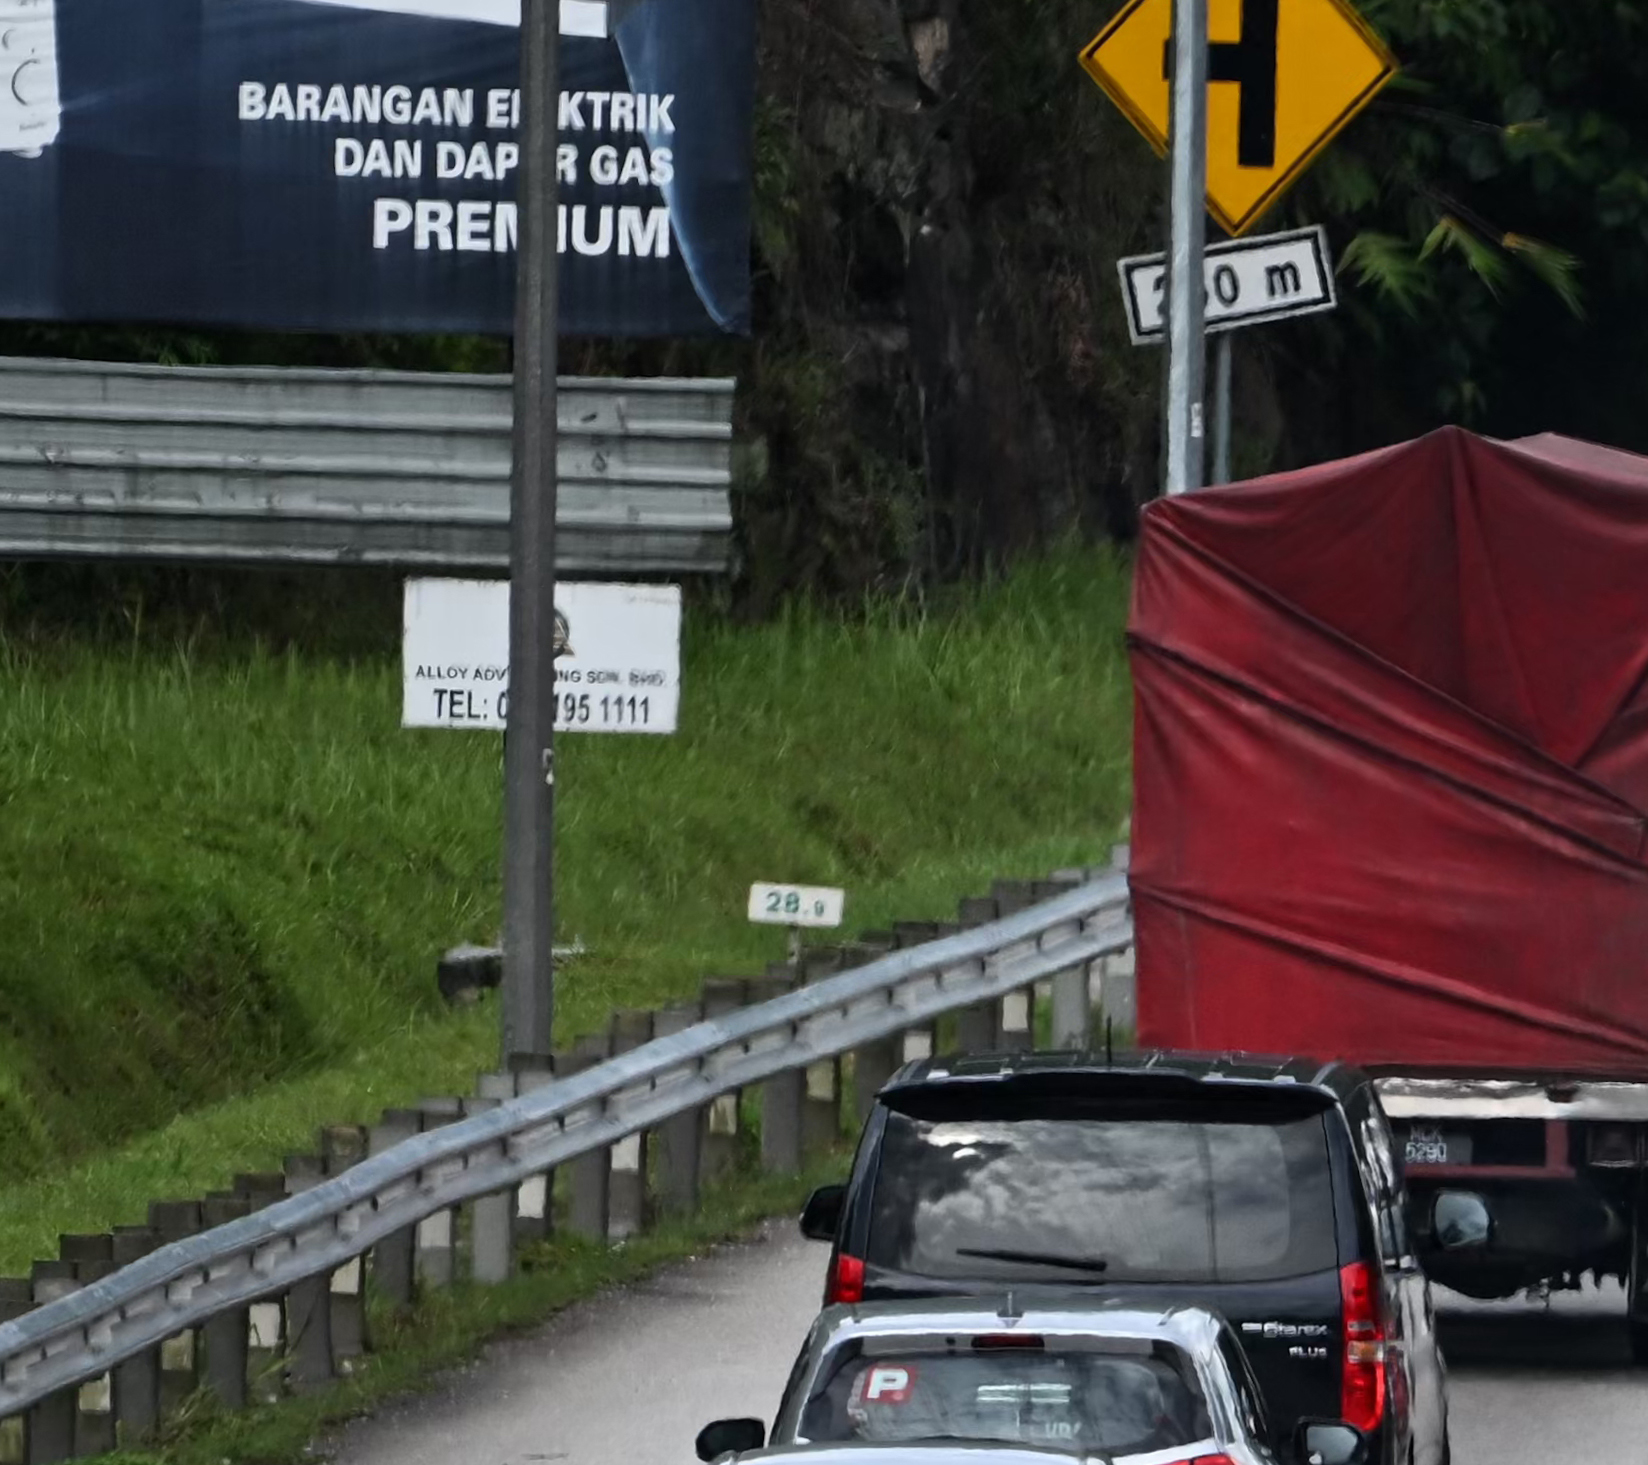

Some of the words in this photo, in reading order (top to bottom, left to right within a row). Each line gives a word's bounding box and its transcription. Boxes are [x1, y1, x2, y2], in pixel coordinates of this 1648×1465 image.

[238, 82, 473, 127] BARANGAN
[334, 138, 422, 178] DAN
[436, 141, 579, 185] DAPR
[590, 145, 675, 187] GAS
[1264, 261, 1301, 297] m
[414, 665, 468, 680] ALLOY
[433, 689, 488, 720] TEL:
[599, 696, 650, 724] 1111
[866, 1367, 909, 1400] P
